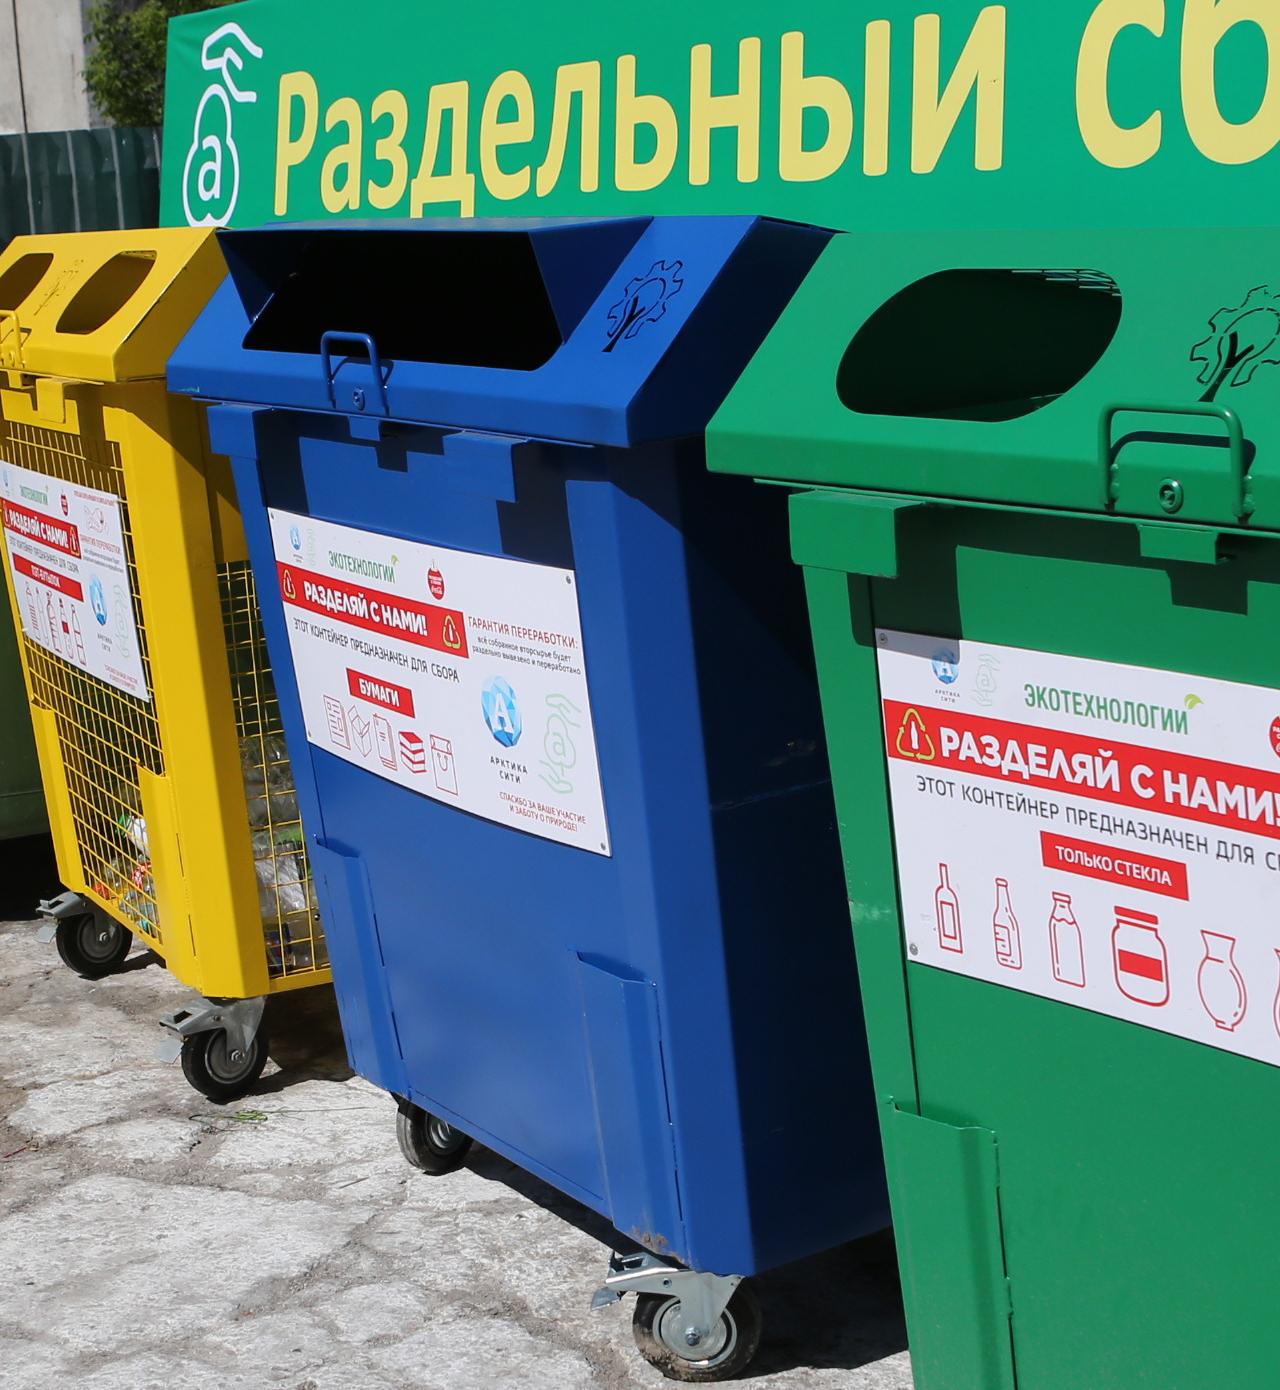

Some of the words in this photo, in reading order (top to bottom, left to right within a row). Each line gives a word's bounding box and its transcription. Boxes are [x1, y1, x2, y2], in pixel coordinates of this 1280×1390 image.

[273, 4, 1007, 219] Раздельный
[329, 550, 395, 583] ЭКОТЕХНОЛОГИИ
[304, 581, 369, 620] РАЗДЕЛЯЙ
[370, 601, 380, 622] С
[381, 604, 428, 636] НАМИ!
[468, 616, 510, 634] ГАРАНТИЯ
[511, 626, 578, 649] ПЕРЕРАБОТКИ:
[293, 617, 308, 631] ЭТОТ
[310, 624, 349, 647] КОНТЕЙНЕР
[350, 638, 409, 667] ПРЕДНАЗНАЧЕН
[411, 657, 428, 674] ДЛЯ
[431, 663, 461, 683] СБОРА
[472, 645, 501, 657] раздельно
[536, 661, 581, 675] переработано
[488, 638, 519, 652] собранное
[520, 645, 552, 659] вторсырье
[553, 650, 571, 662] будет
[359, 678, 400, 707] БУМАГИ
[1024, 683, 1188, 735] ЭКОТЕХНОЛОГИИ
[490, 755, 528, 775] АРКТИКА
[499, 770, 521, 784] СИТИ
[939, 726, 1121, 793] РАЗДЕЛЯЙ
[1130, 764, 1156, 799] С
[499, 792, 528, 808] СПАСИБО
[528, 800, 536, 809] ЗА
[537, 803, 556, 816] ВАШЕ
[556, 807, 586, 825] УЧАСТИЕ
[515, 806, 539, 821] ЗАБОТУ
[545, 816, 578, 832] ПРИРОДЕ!
[916, 775, 955, 798] ЭТОТ
[961, 785, 1059, 819] КОНТЕЙНЕР
[1065, 806, 1209, 854] ПРЕДНАЗНАЧЕН
[1216, 840, 1255, 865] ДЛЯ
[1055, 845, 1113, 872] ТОЛЬКО
[1114, 859, 1173, 886] СТЕКЛА
